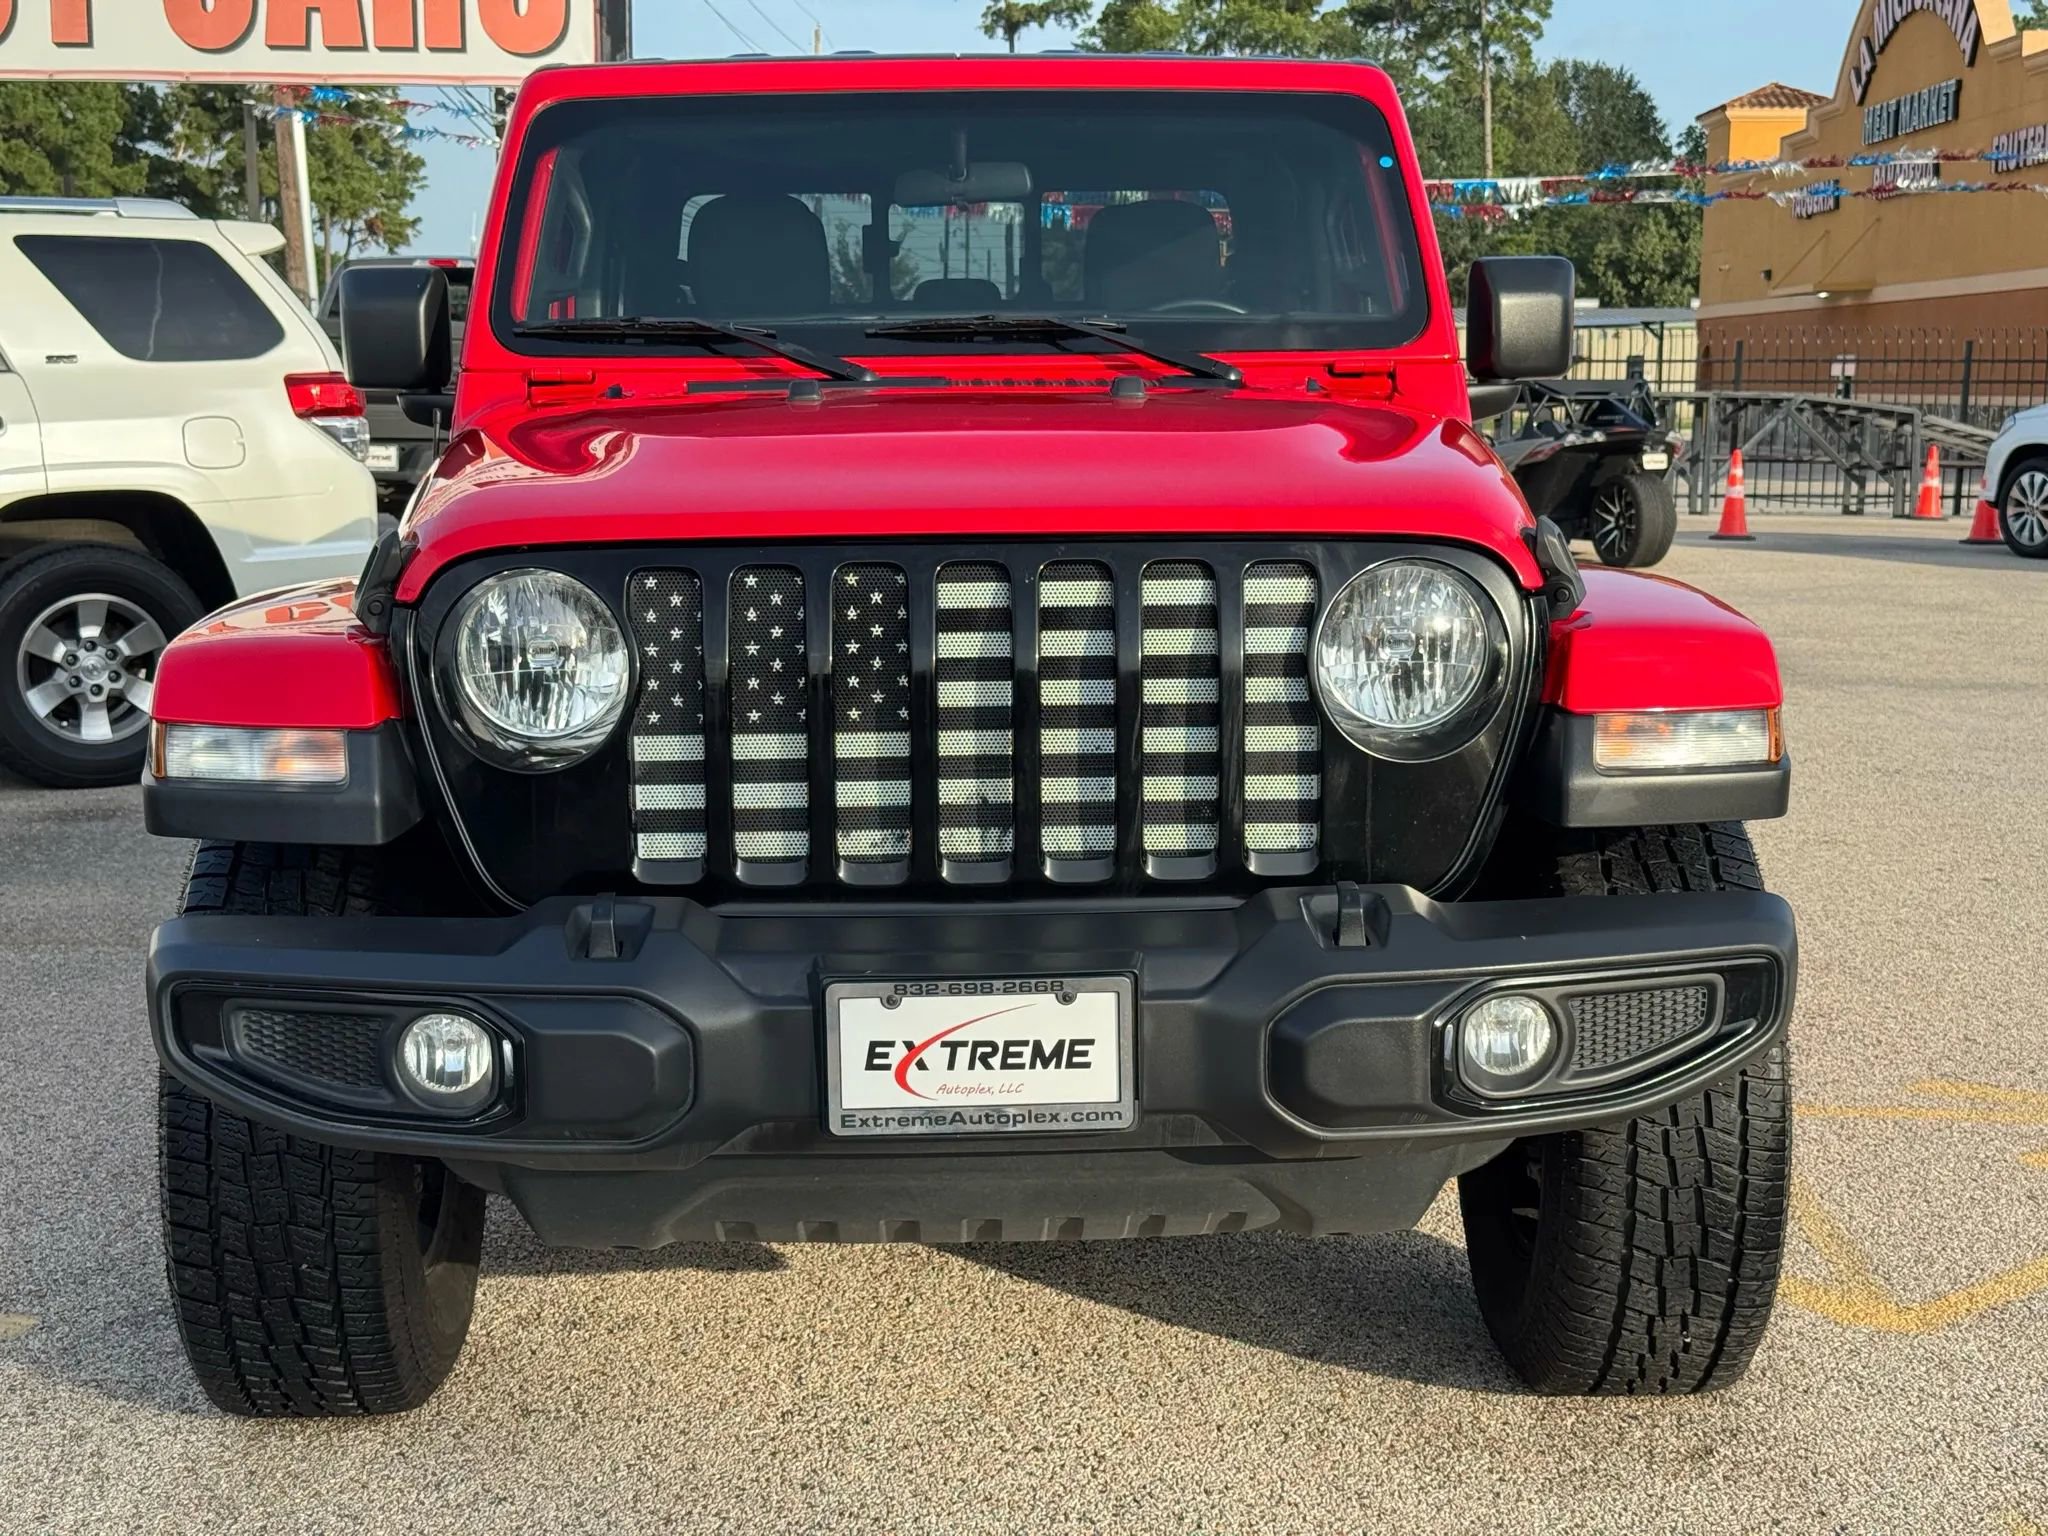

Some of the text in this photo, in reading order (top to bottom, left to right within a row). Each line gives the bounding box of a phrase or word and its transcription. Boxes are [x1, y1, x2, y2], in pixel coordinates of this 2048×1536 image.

[1850, 37, 1874, 106] LA
[1862, 79, 1957, 146] MEAT MARKET
[893, 979, 1064, 996] 832-698-2668
[865, 1039, 1096, 1071] EXTREME
[936, 1083, 1025, 1097] Autoplex, LLC
[840, 1110, 1123, 1129] ExtremeAutoplex.com
